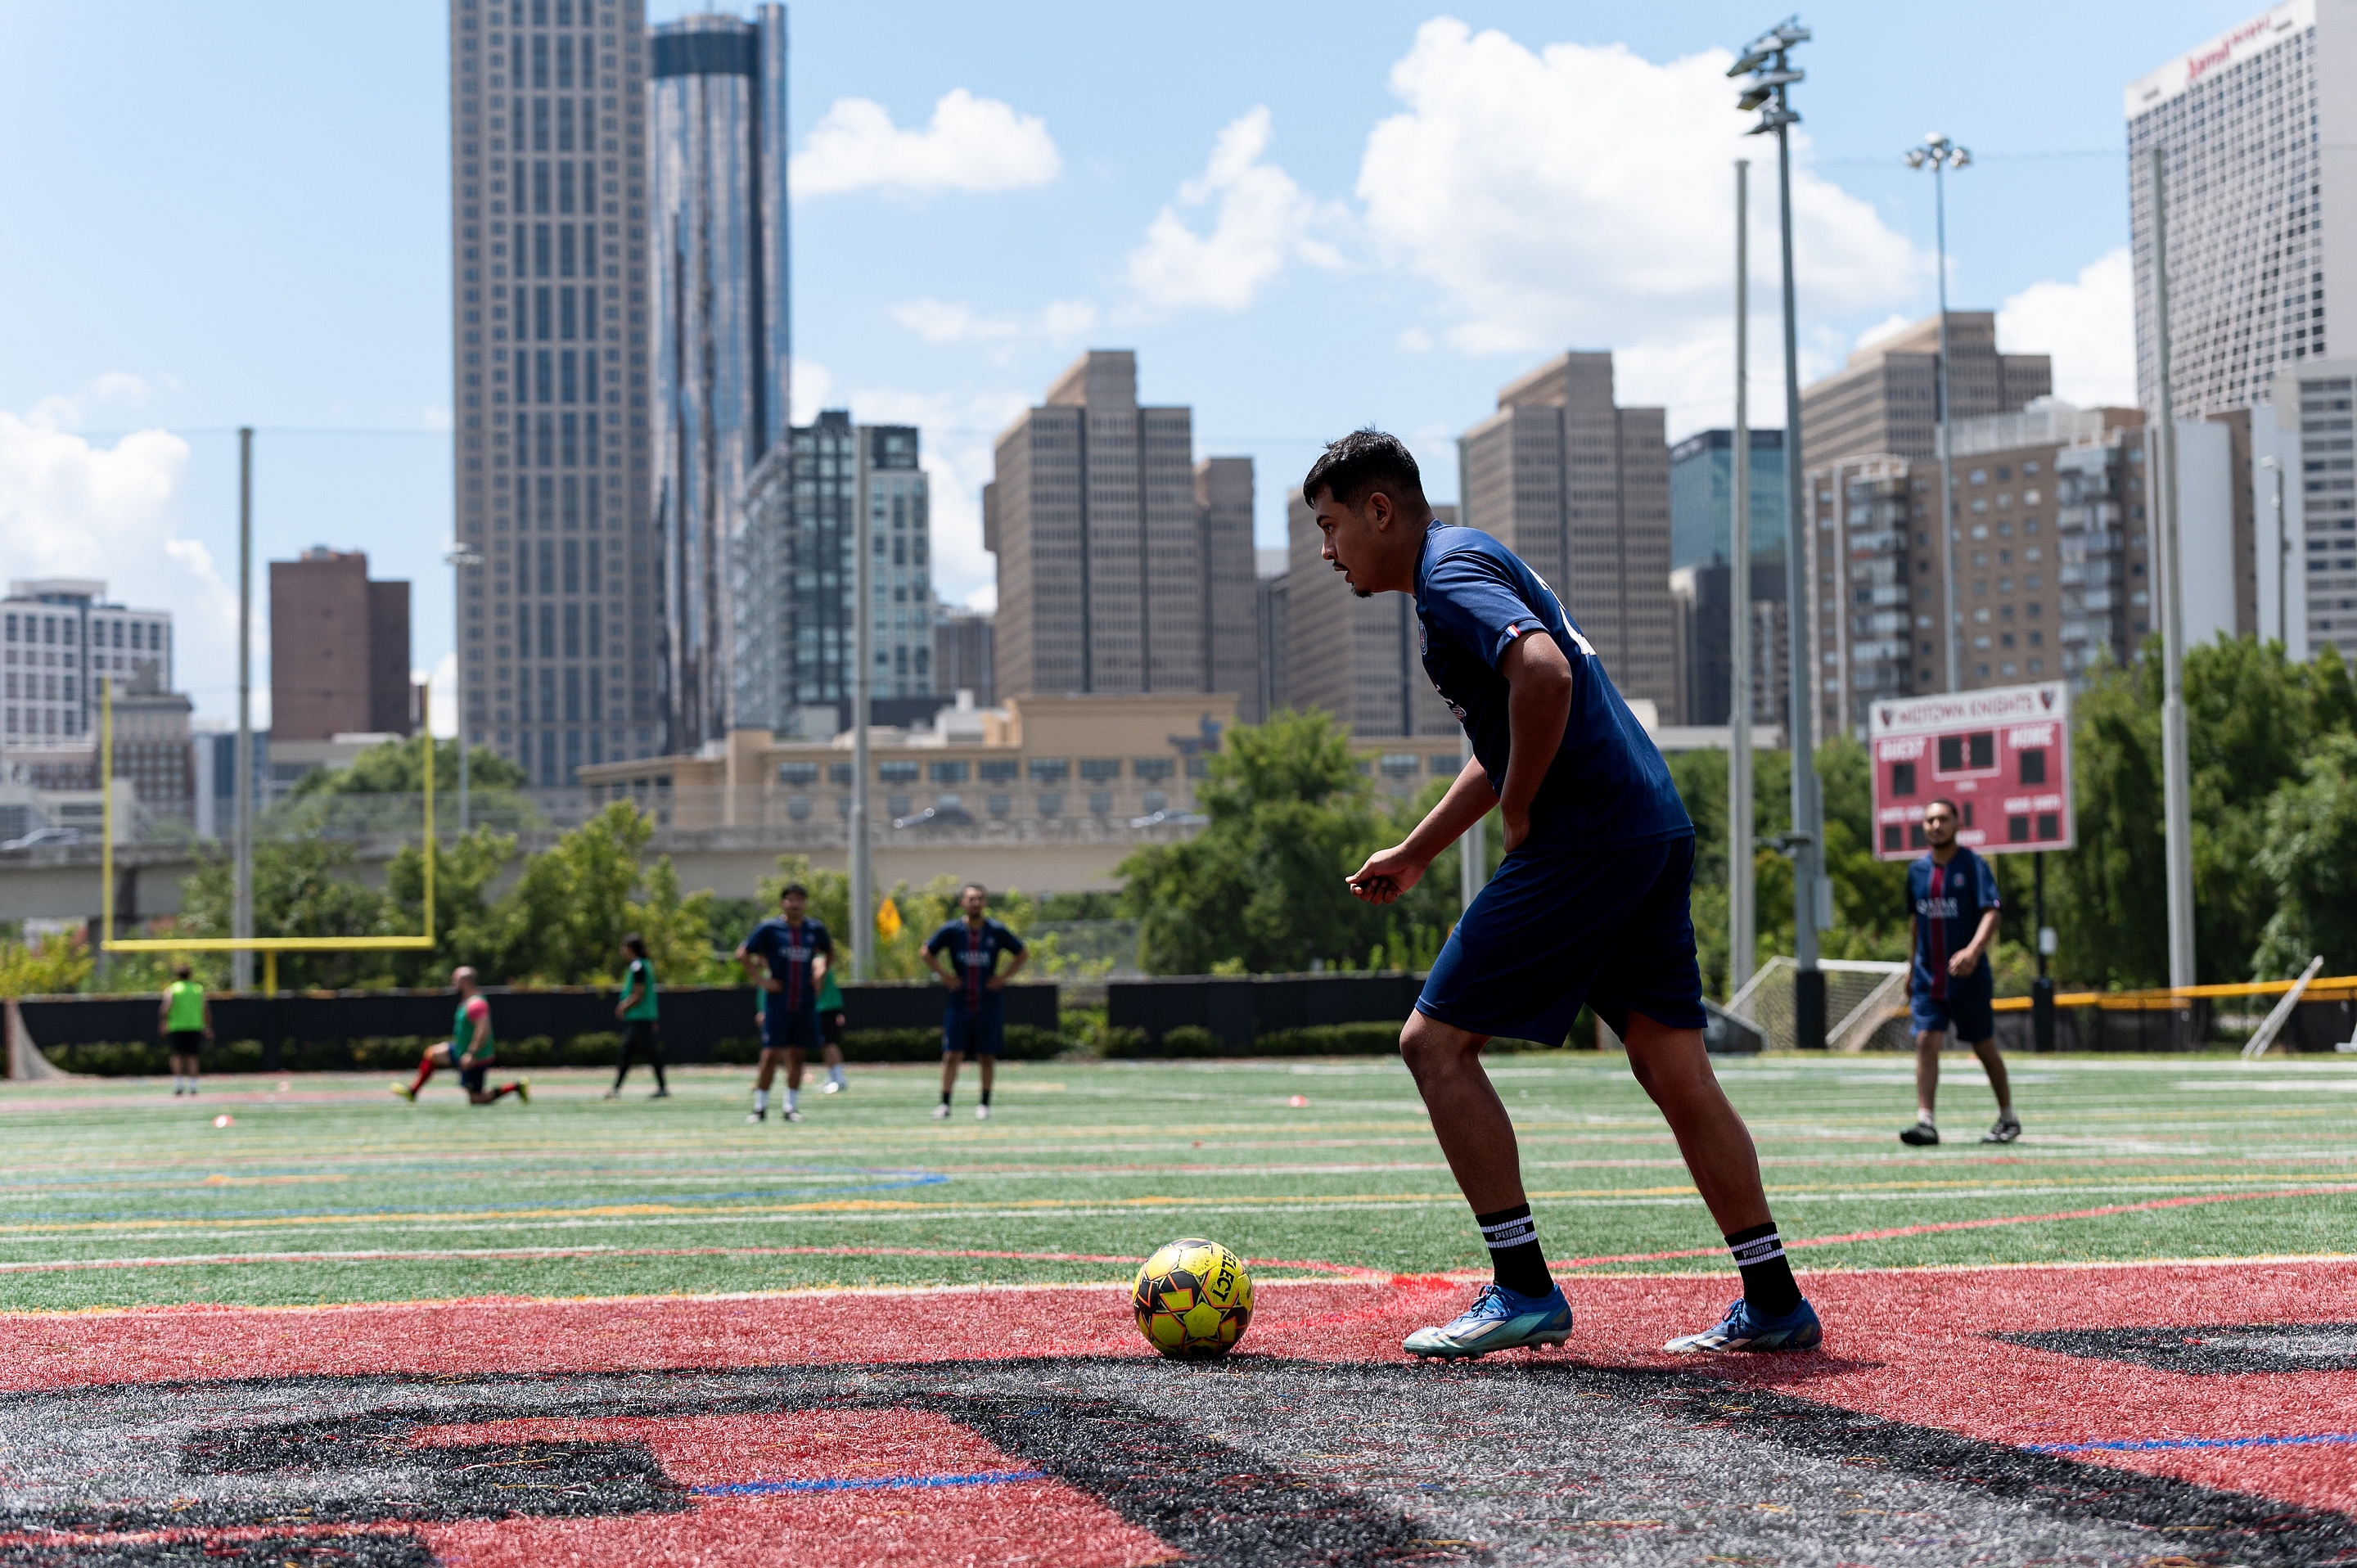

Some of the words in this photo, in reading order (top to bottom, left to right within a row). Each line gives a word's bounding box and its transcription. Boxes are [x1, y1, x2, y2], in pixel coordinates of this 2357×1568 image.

[1900, 702, 1965, 724] MIDTOWN
[1970, 695, 2033, 717] KNIGHTS
[2009, 725, 2053, 748] HOME
[1881, 737, 1925, 761] GUEST
[1494, 1225, 1526, 1241] PUMA
[1742, 1242, 1773, 1258] PUMA
[1212, 1249, 1237, 1302] SELECT
